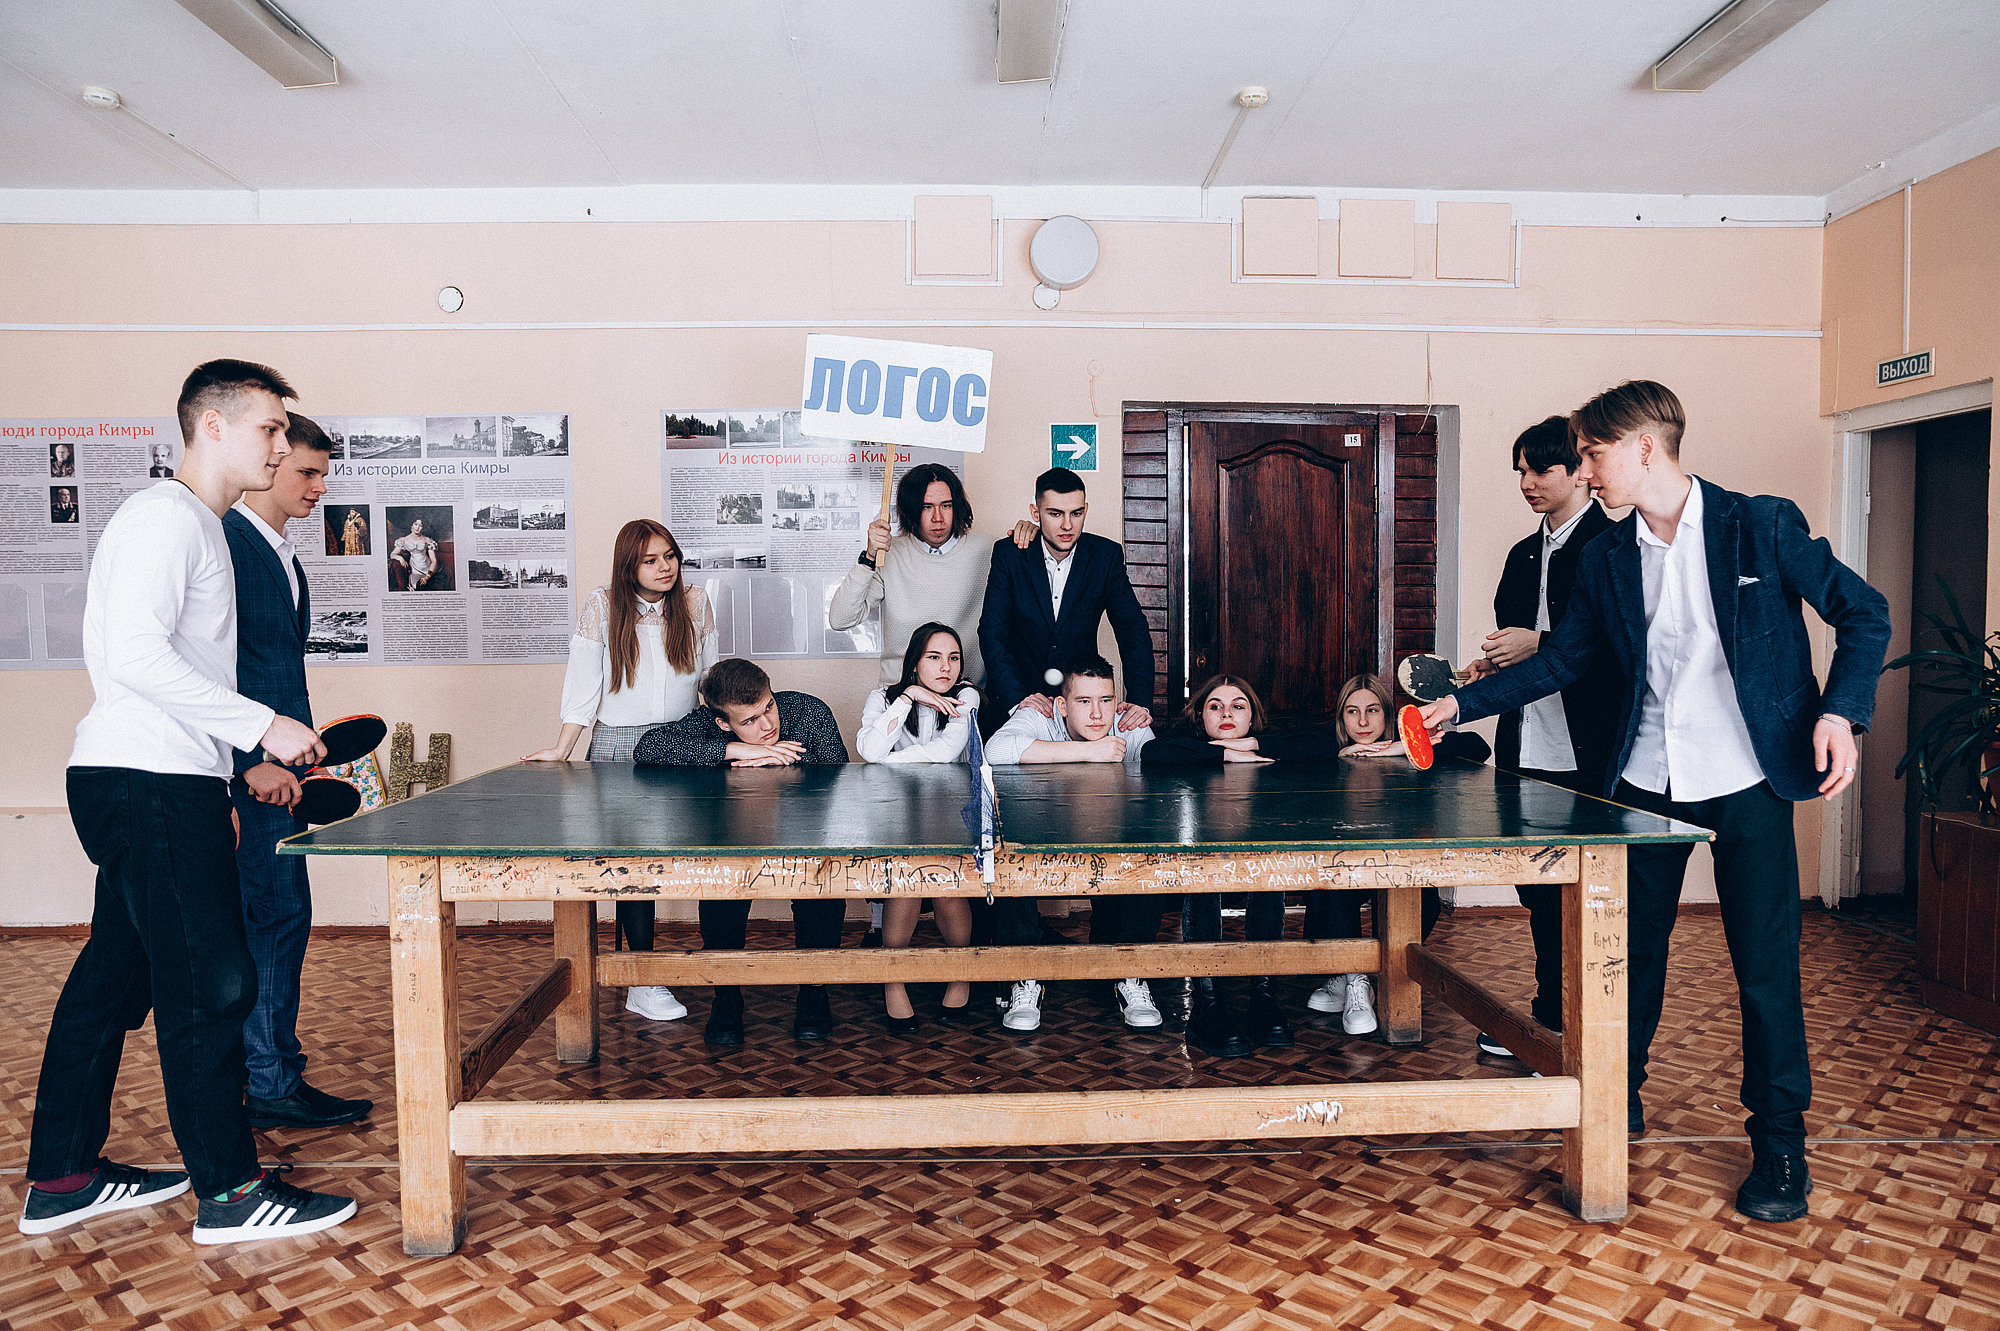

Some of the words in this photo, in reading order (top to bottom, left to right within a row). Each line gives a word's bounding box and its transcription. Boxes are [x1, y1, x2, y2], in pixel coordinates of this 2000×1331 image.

[1882, 355, 1928, 380] ВЫХОД
[803, 356, 987, 427] ЛОГОС
[0, 425, 35, 439] юди
[40, 425, 94, 440] города
[99, 423, 155, 439] Кимры
[1349, 435, 1358, 444] 15
[718, 452, 737, 465] Из
[742, 452, 801, 467] истории
[806, 451, 857, 466] города
[334, 463, 353, 476] Из
[357, 463, 417, 478] истории
[421, 463, 456, 475] села
[461, 461, 510, 477] Кимры
